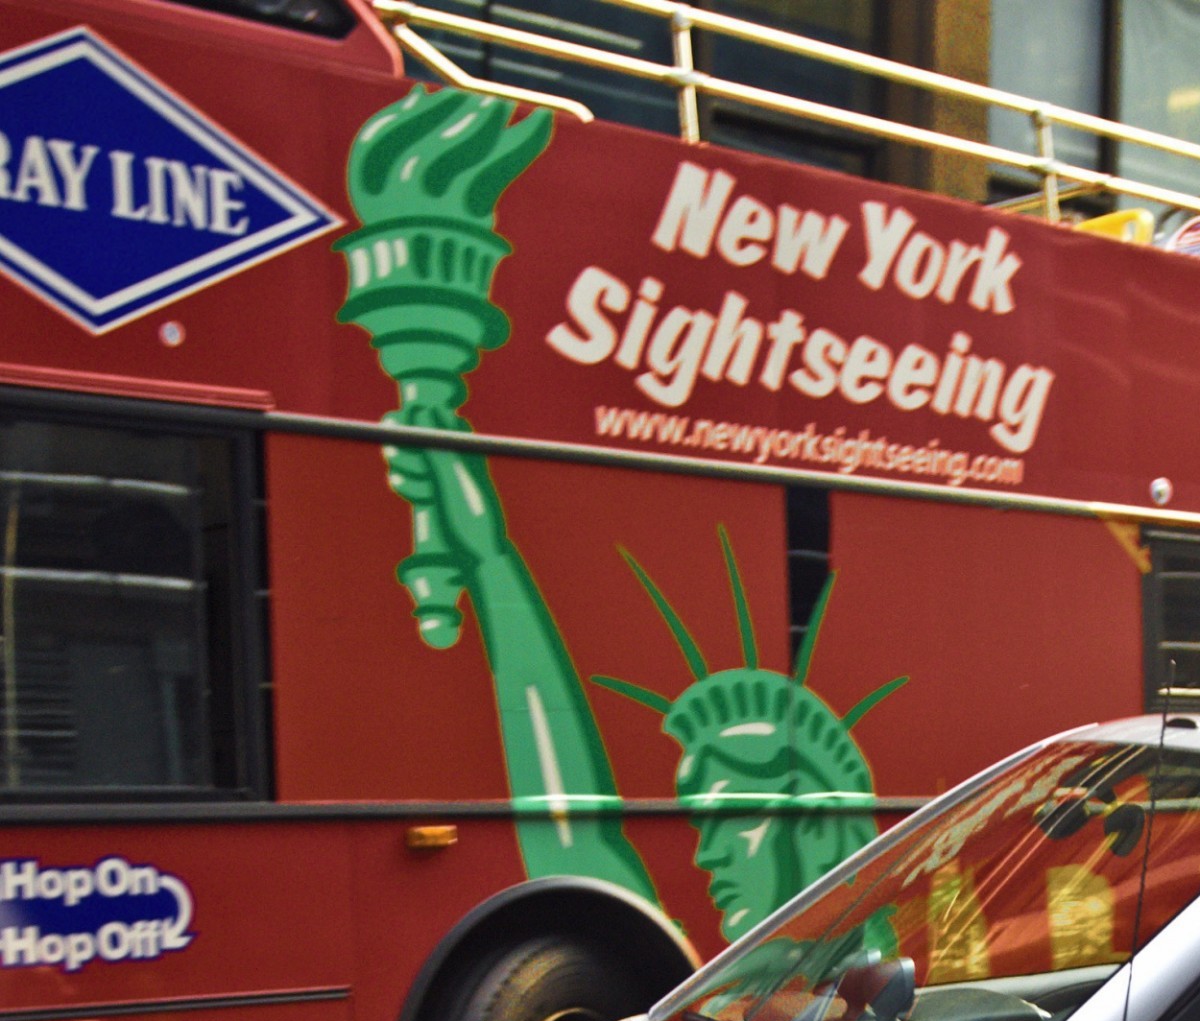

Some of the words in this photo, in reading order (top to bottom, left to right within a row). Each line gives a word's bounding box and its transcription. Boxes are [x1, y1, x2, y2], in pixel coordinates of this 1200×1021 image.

[108, 150, 249, 236] LINE
[651, 160, 849, 280] New
[859, 200, 1022, 314] York
[545, 265, 1055, 453] Sightseeing
[595, 405, 1024, 485] www.newyorksightseeing.com
[1, 860, 95, 906] Hop
[96, 857, 158, 897] On
[0, 925, 96, 971] Hop
[97, 919, 162, 960] Off
